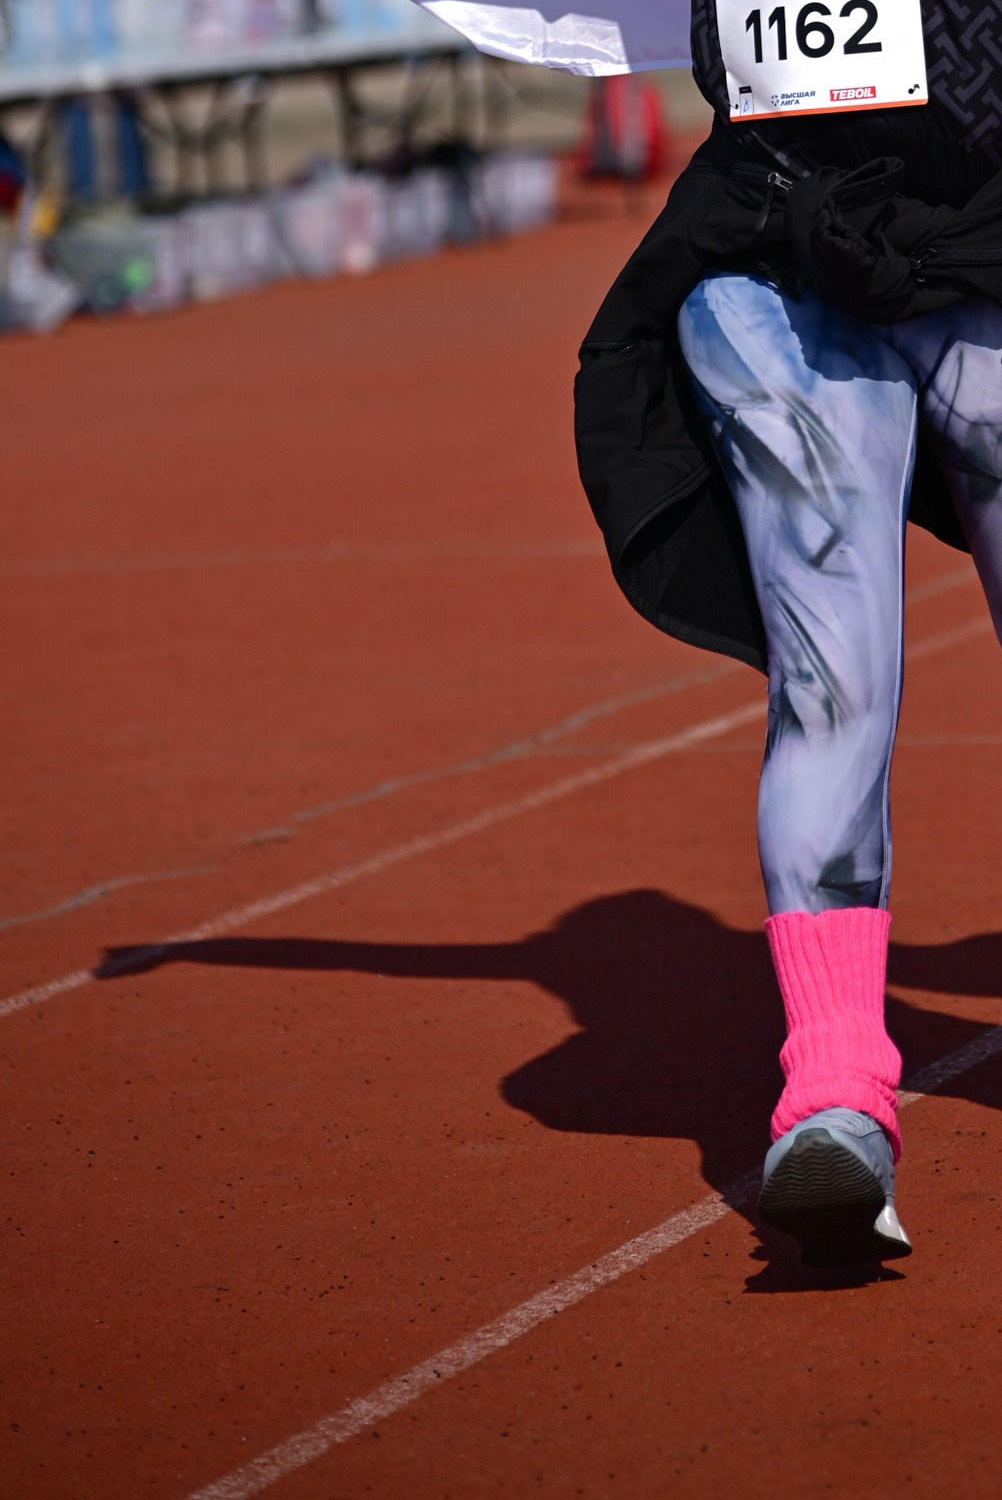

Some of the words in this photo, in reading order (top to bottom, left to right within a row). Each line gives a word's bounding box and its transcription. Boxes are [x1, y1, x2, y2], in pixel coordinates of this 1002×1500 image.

[780, 91, 816, 100] ВЫСШАЯ
[831, 88, 875, 100] TEBOIL
[780, 99, 800, 107] ЛИГА
